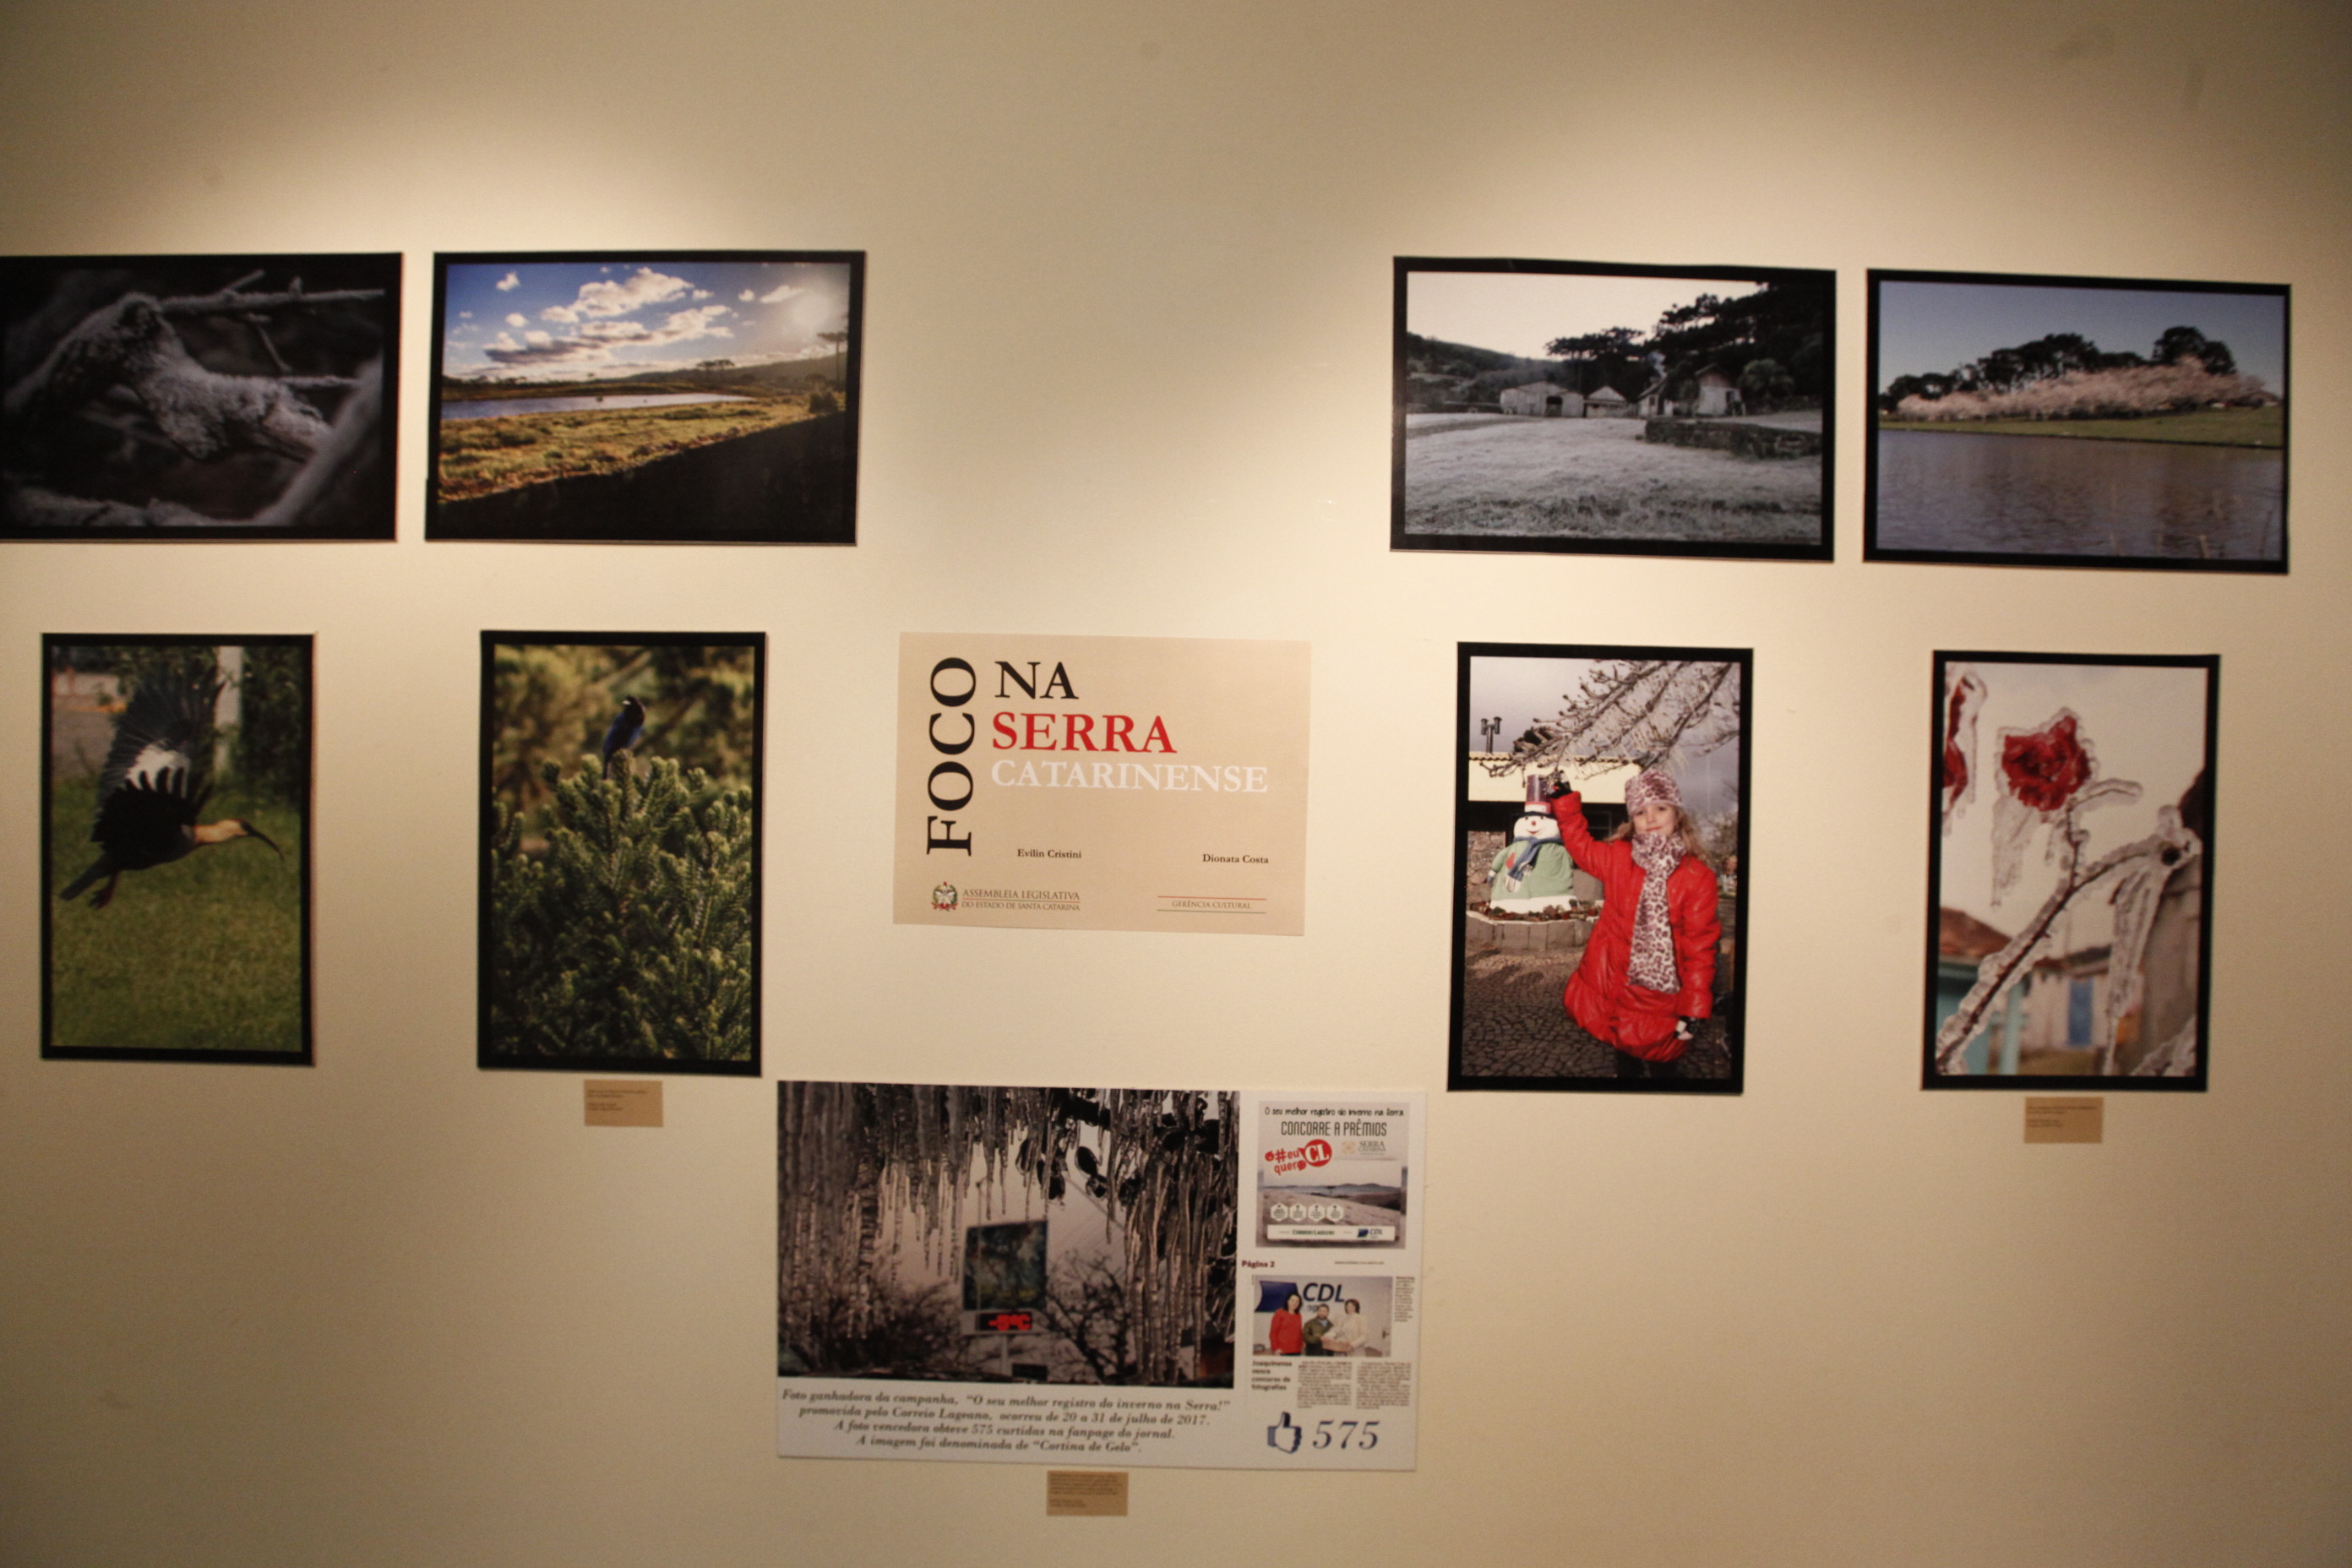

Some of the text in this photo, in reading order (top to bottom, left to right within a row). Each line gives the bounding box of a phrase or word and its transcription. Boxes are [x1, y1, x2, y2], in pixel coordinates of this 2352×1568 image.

[994, 660, 1079, 700] NA
[992, 710, 1178, 754] SERRA
[926, 656, 977, 857] FOCO
[991, 759, 1268, 793] CATARINENSE
[1017, 848, 1081, 859] Evilin Cristini
[1202, 853, 1269, 863] Dionata Costa
[962, 890, 1080, 901] ASSEMBLEIA LEGISLATIVA
[1172, 899, 1250, 910] GERÊNCIA CULTURAL
[976, 901, 1004, 910] ESTADO
[1017, 902, 1041, 911] SANTA
[1043, 902, 1080, 912] CATARINA
[1265, 1107, 1270, 1115] O
[1285, 1107, 1309, 1116] melhor
[1310, 1108, 1335, 1118] registro
[1281, 1119, 1387, 1137] CONCORRE A PRÊMIOS
[1304, 1144, 1330, 1163] CL
[1242, 1260, 1268, 1269] Página
[1303, 1282, 1345, 1302] CDL
[782, 1389, 807, 1400] Foto
[808, 1391, 871, 1403] ganhadora
[875, 1391, 890, 1402] da
[893, 1393, 959, 1407] campanha,
[986, 1396, 1004, 1406] seu
[1009, 1396, 1048, 1407] melhor
[1053, 1397, 1096, 1410] registro
[1099, 1397, 1113, 1408] do
[1117, 1398, 1162, 1410] inverno
[1165, 1402, 1181, 1410] na
[798, 1406, 861, 1418] promovida
[864, 1407, 888, 1420] pelo
[892, 1407, 935, 1419] Correio
[999, 1413, 1042, 1422] ocorreu
[1046, 1412, 1059, 1422] de
[1062, 1412, 1077, 1423] 20
[1092, 1413, 1104, 1424] 31
[1109, 1413, 1123, 1424] de
[1125, 1413, 1157, 1426] julho
[1161, 1413, 1173, 1424] de
[1177, 1414, 1211, 1426] 2017.
[834, 1420, 1175, 1441] A foto vencedora obteve 575 curtidas na fanpage do jornal.
[1312, 1419, 1380, 1451] 575
[856, 1435, 866, 1446] A
[870, 1436, 917, 1447] imagem
[918, 1436, 935, 1450] foi
[939, 1438, 1011, 1451] denominada
[1015, 1440, 1029, 1451] de
[1088, 1441, 1102, 1451] de
